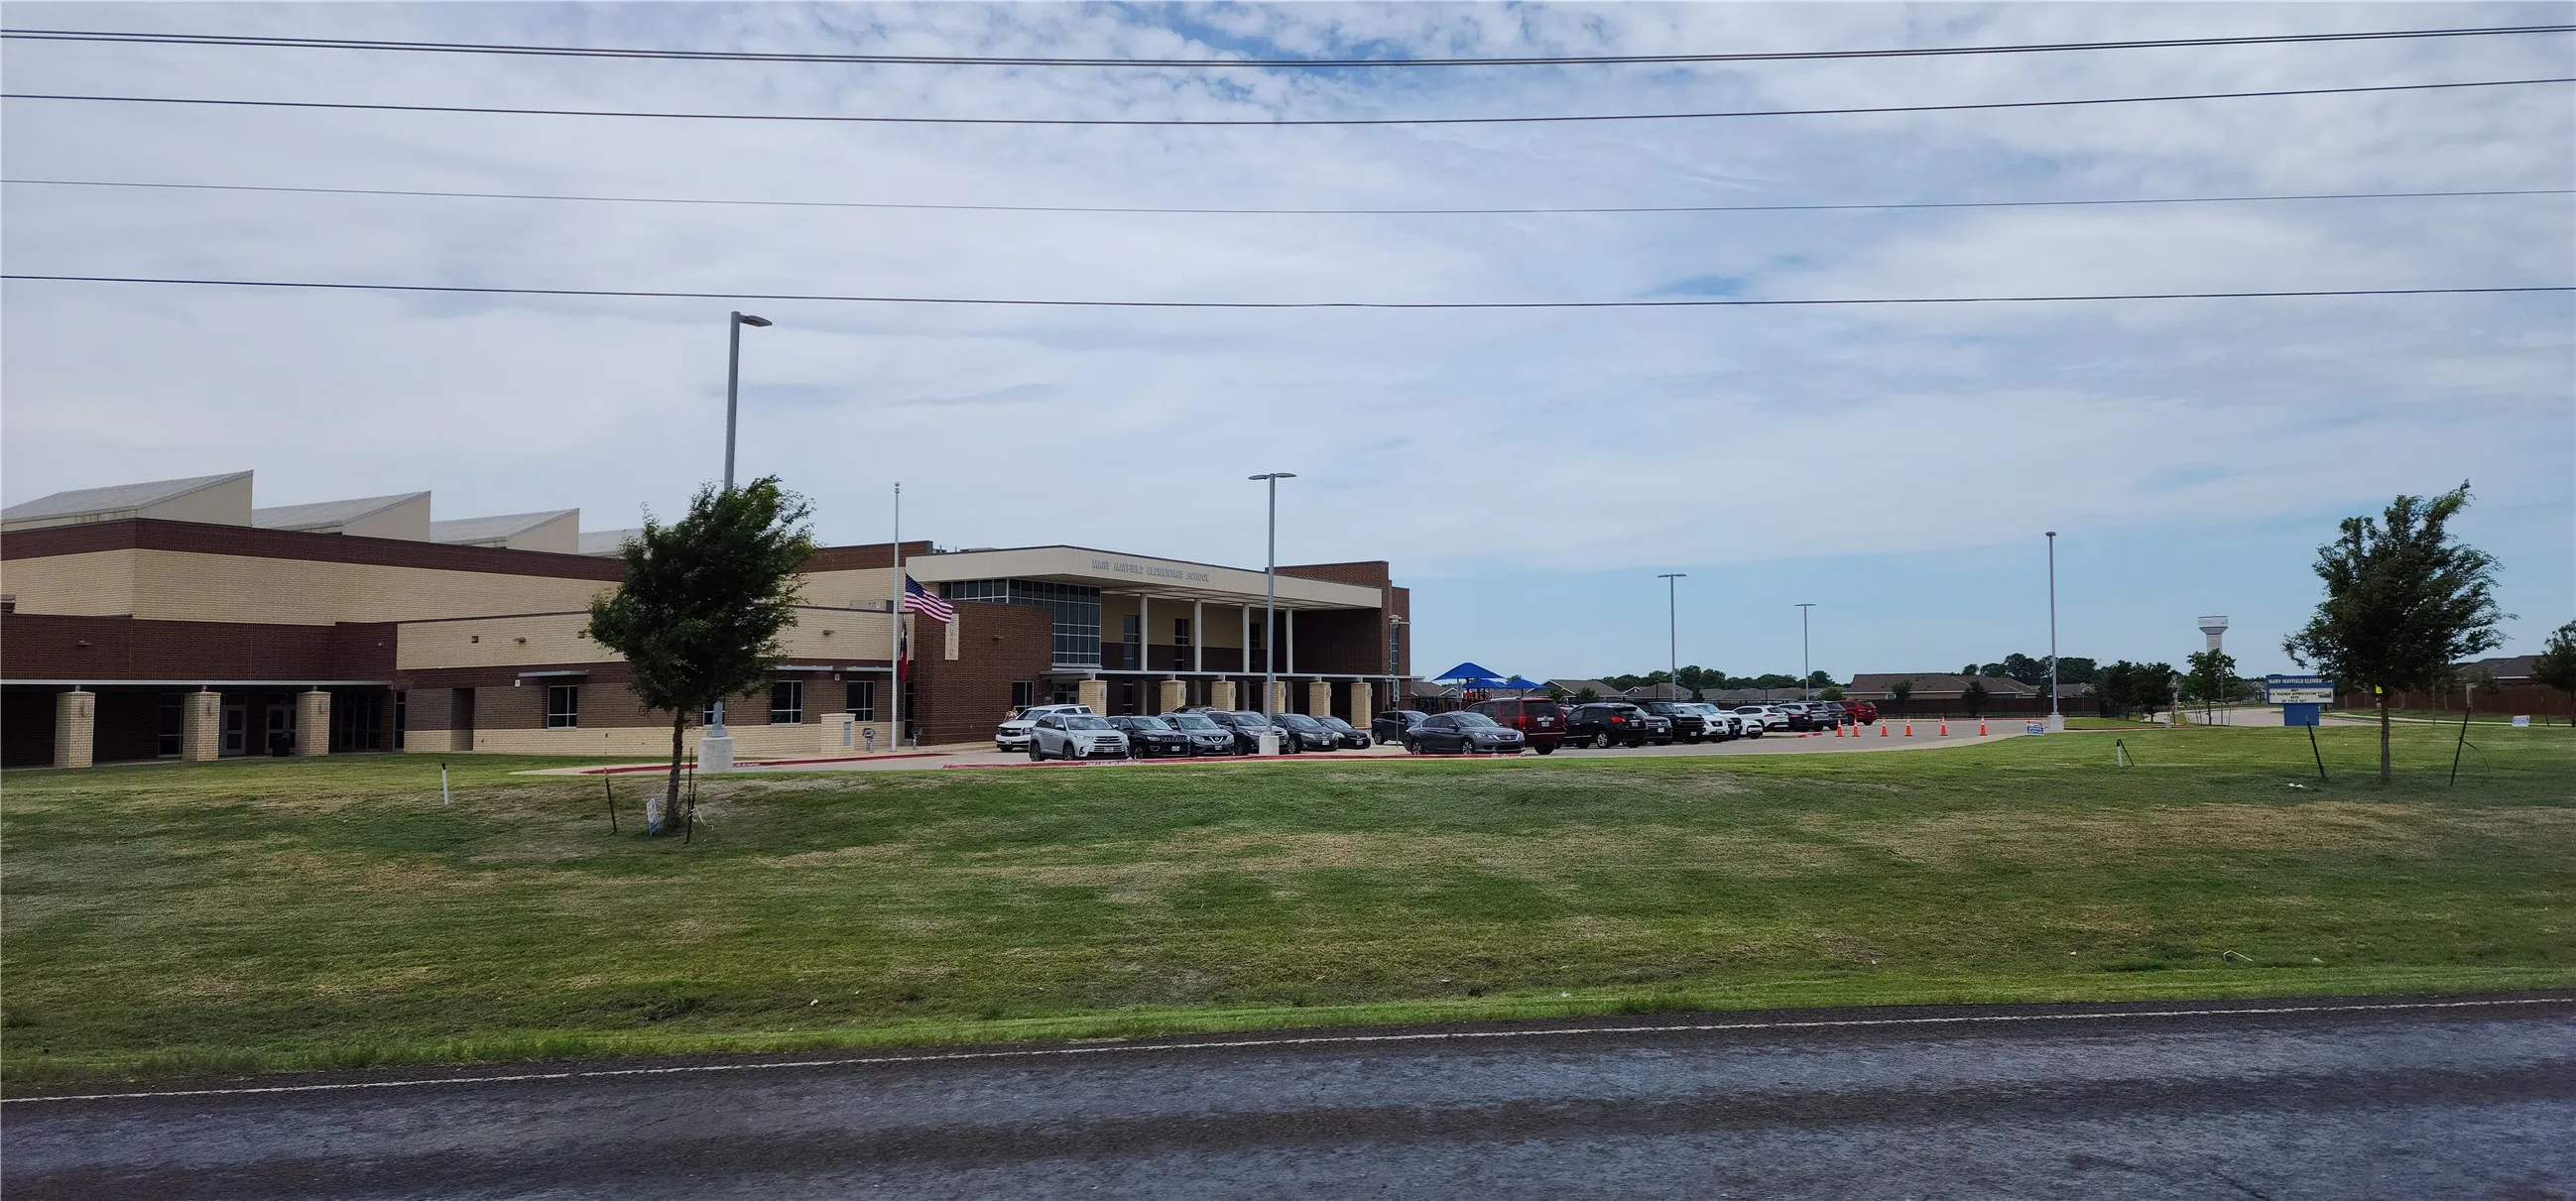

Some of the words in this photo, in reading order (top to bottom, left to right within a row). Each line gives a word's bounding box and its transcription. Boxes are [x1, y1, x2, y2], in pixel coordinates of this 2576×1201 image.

[1091, 560, 1110, 570] MARY
[1114, 562, 1144, 575] MAYFIELD
[1147, 566, 1183, 579] ELEMENTARY
[1186, 572, 1210, 582] SCHOOL
